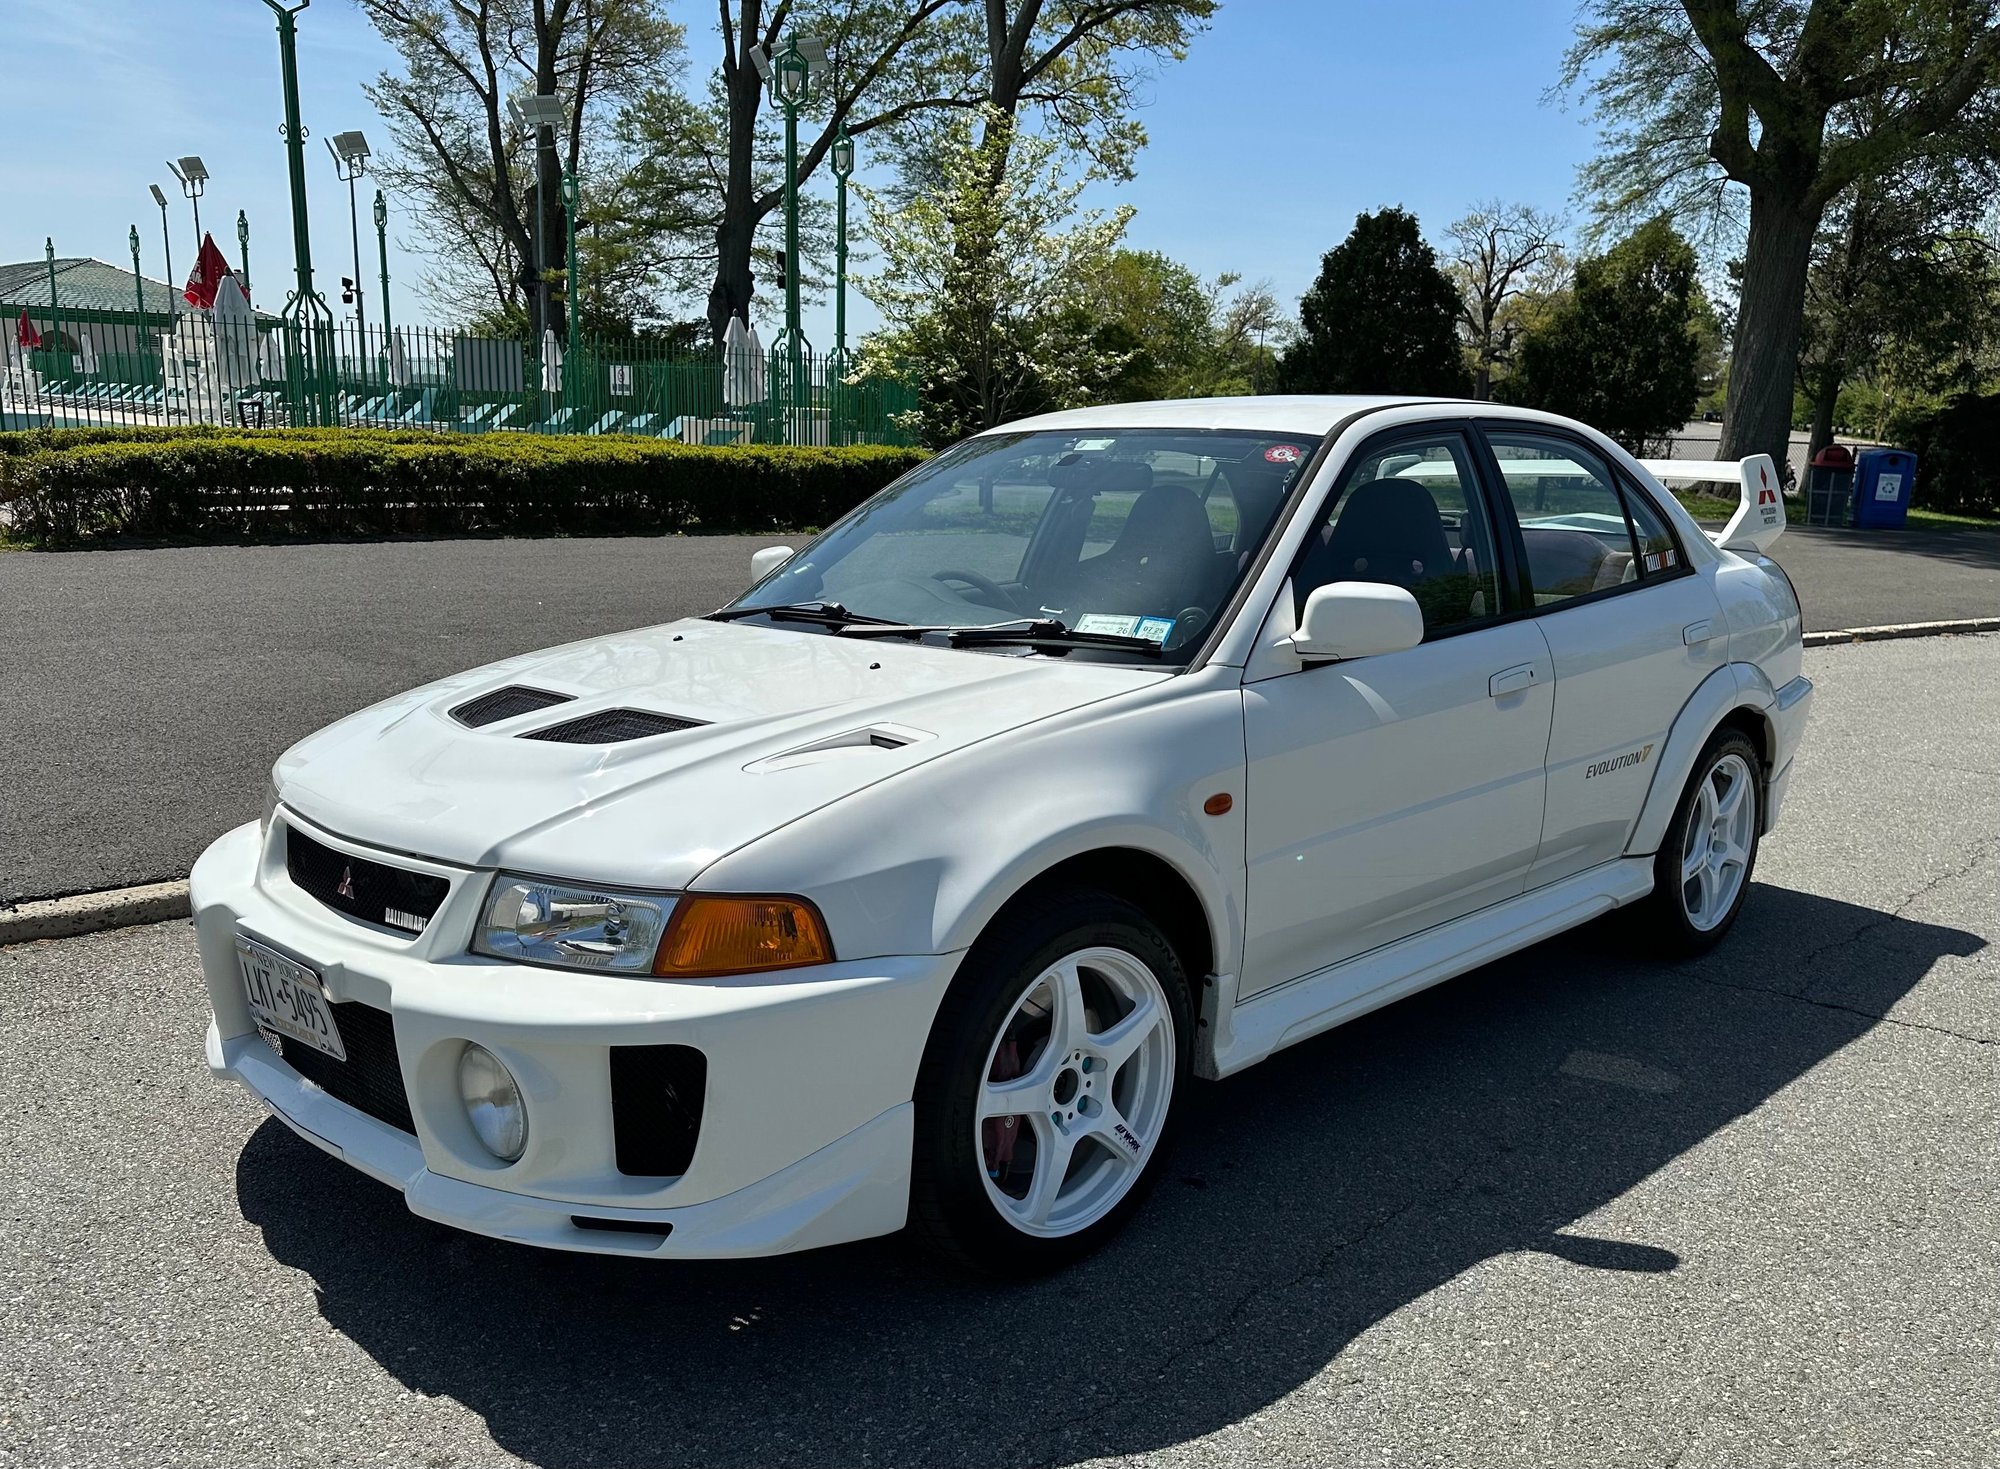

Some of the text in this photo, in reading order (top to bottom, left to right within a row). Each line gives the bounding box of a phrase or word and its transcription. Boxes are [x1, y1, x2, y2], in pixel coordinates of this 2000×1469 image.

[1116, 627, 1129, 635] 26
[1585, 751, 1642, 779] EVOLUTION
[254, 950, 275, 971] NEW
[1124, 1130, 1141, 1152] WORK
